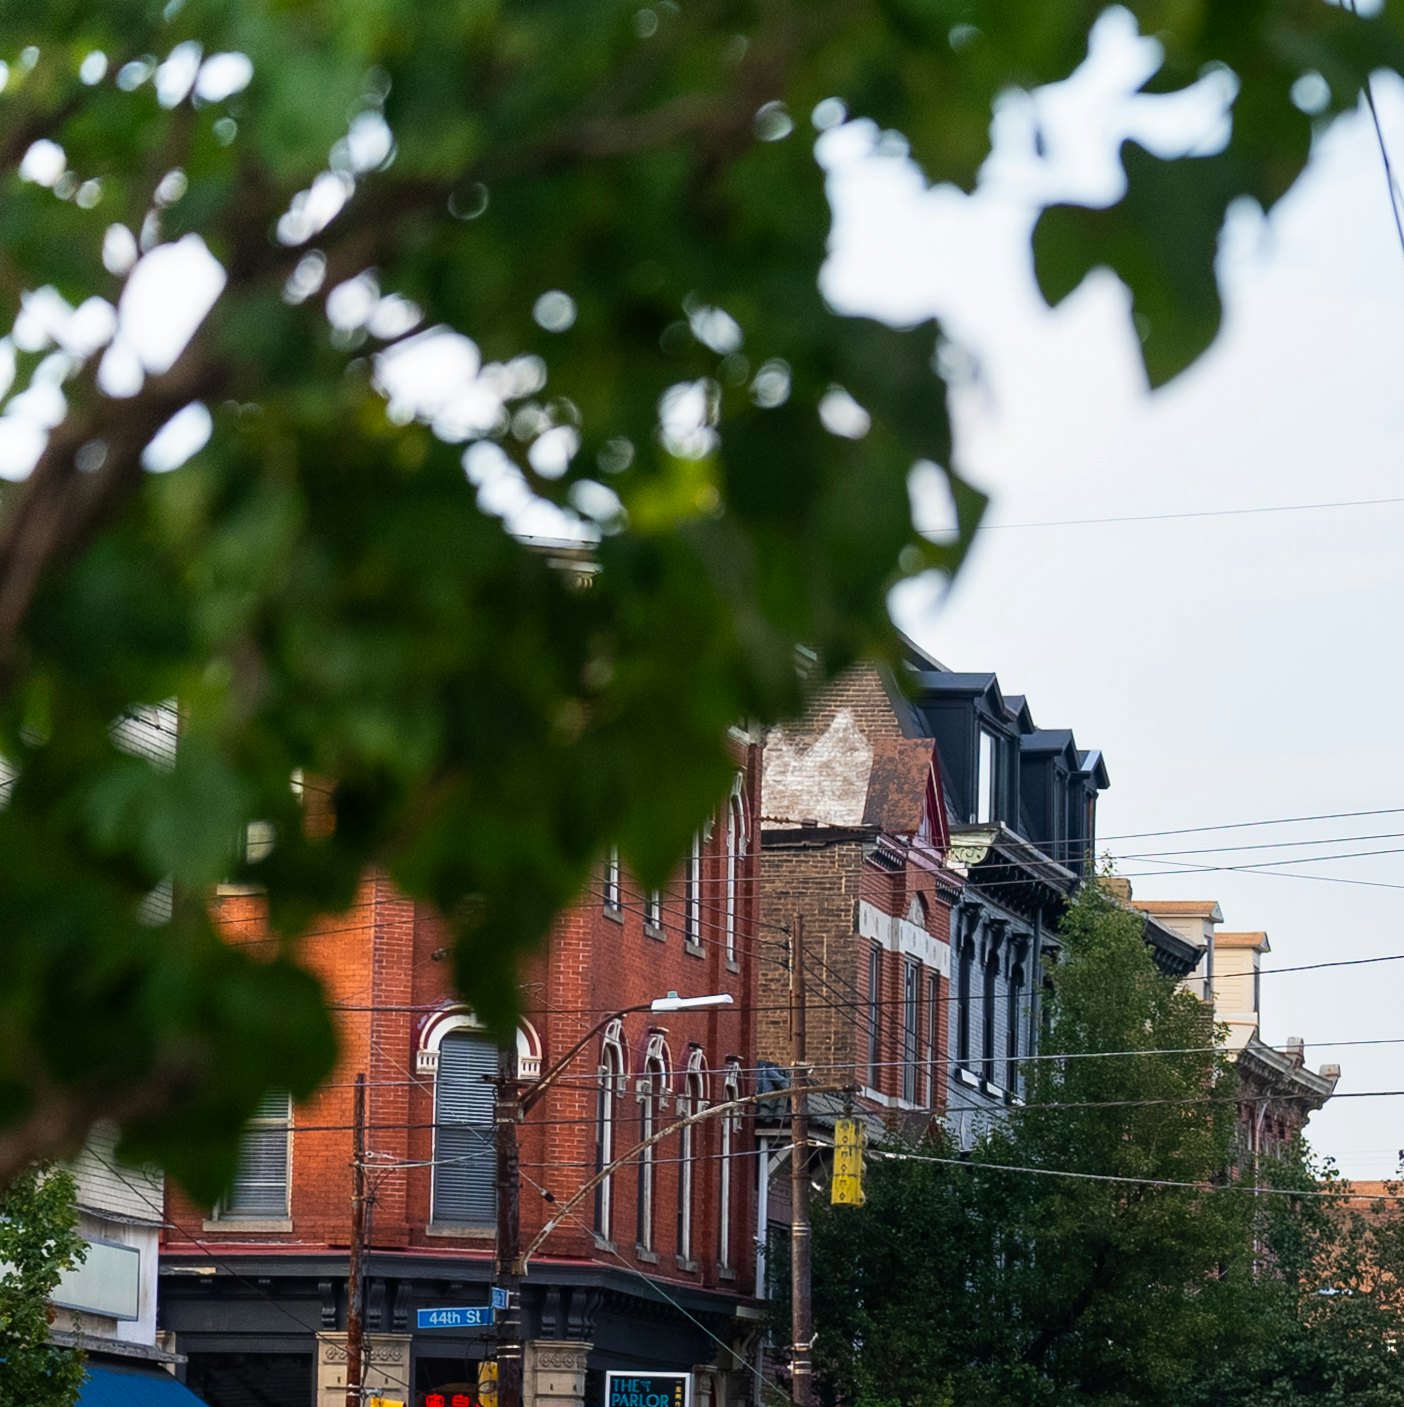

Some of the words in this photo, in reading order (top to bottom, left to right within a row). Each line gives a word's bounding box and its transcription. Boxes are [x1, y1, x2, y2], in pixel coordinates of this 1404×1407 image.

[429, 1312, 460, 1325] 44th
[466, 1310, 481, 1324] St
[612, 1378, 640, 1393] THE
[611, 1393, 669, 1407] PARLOR
